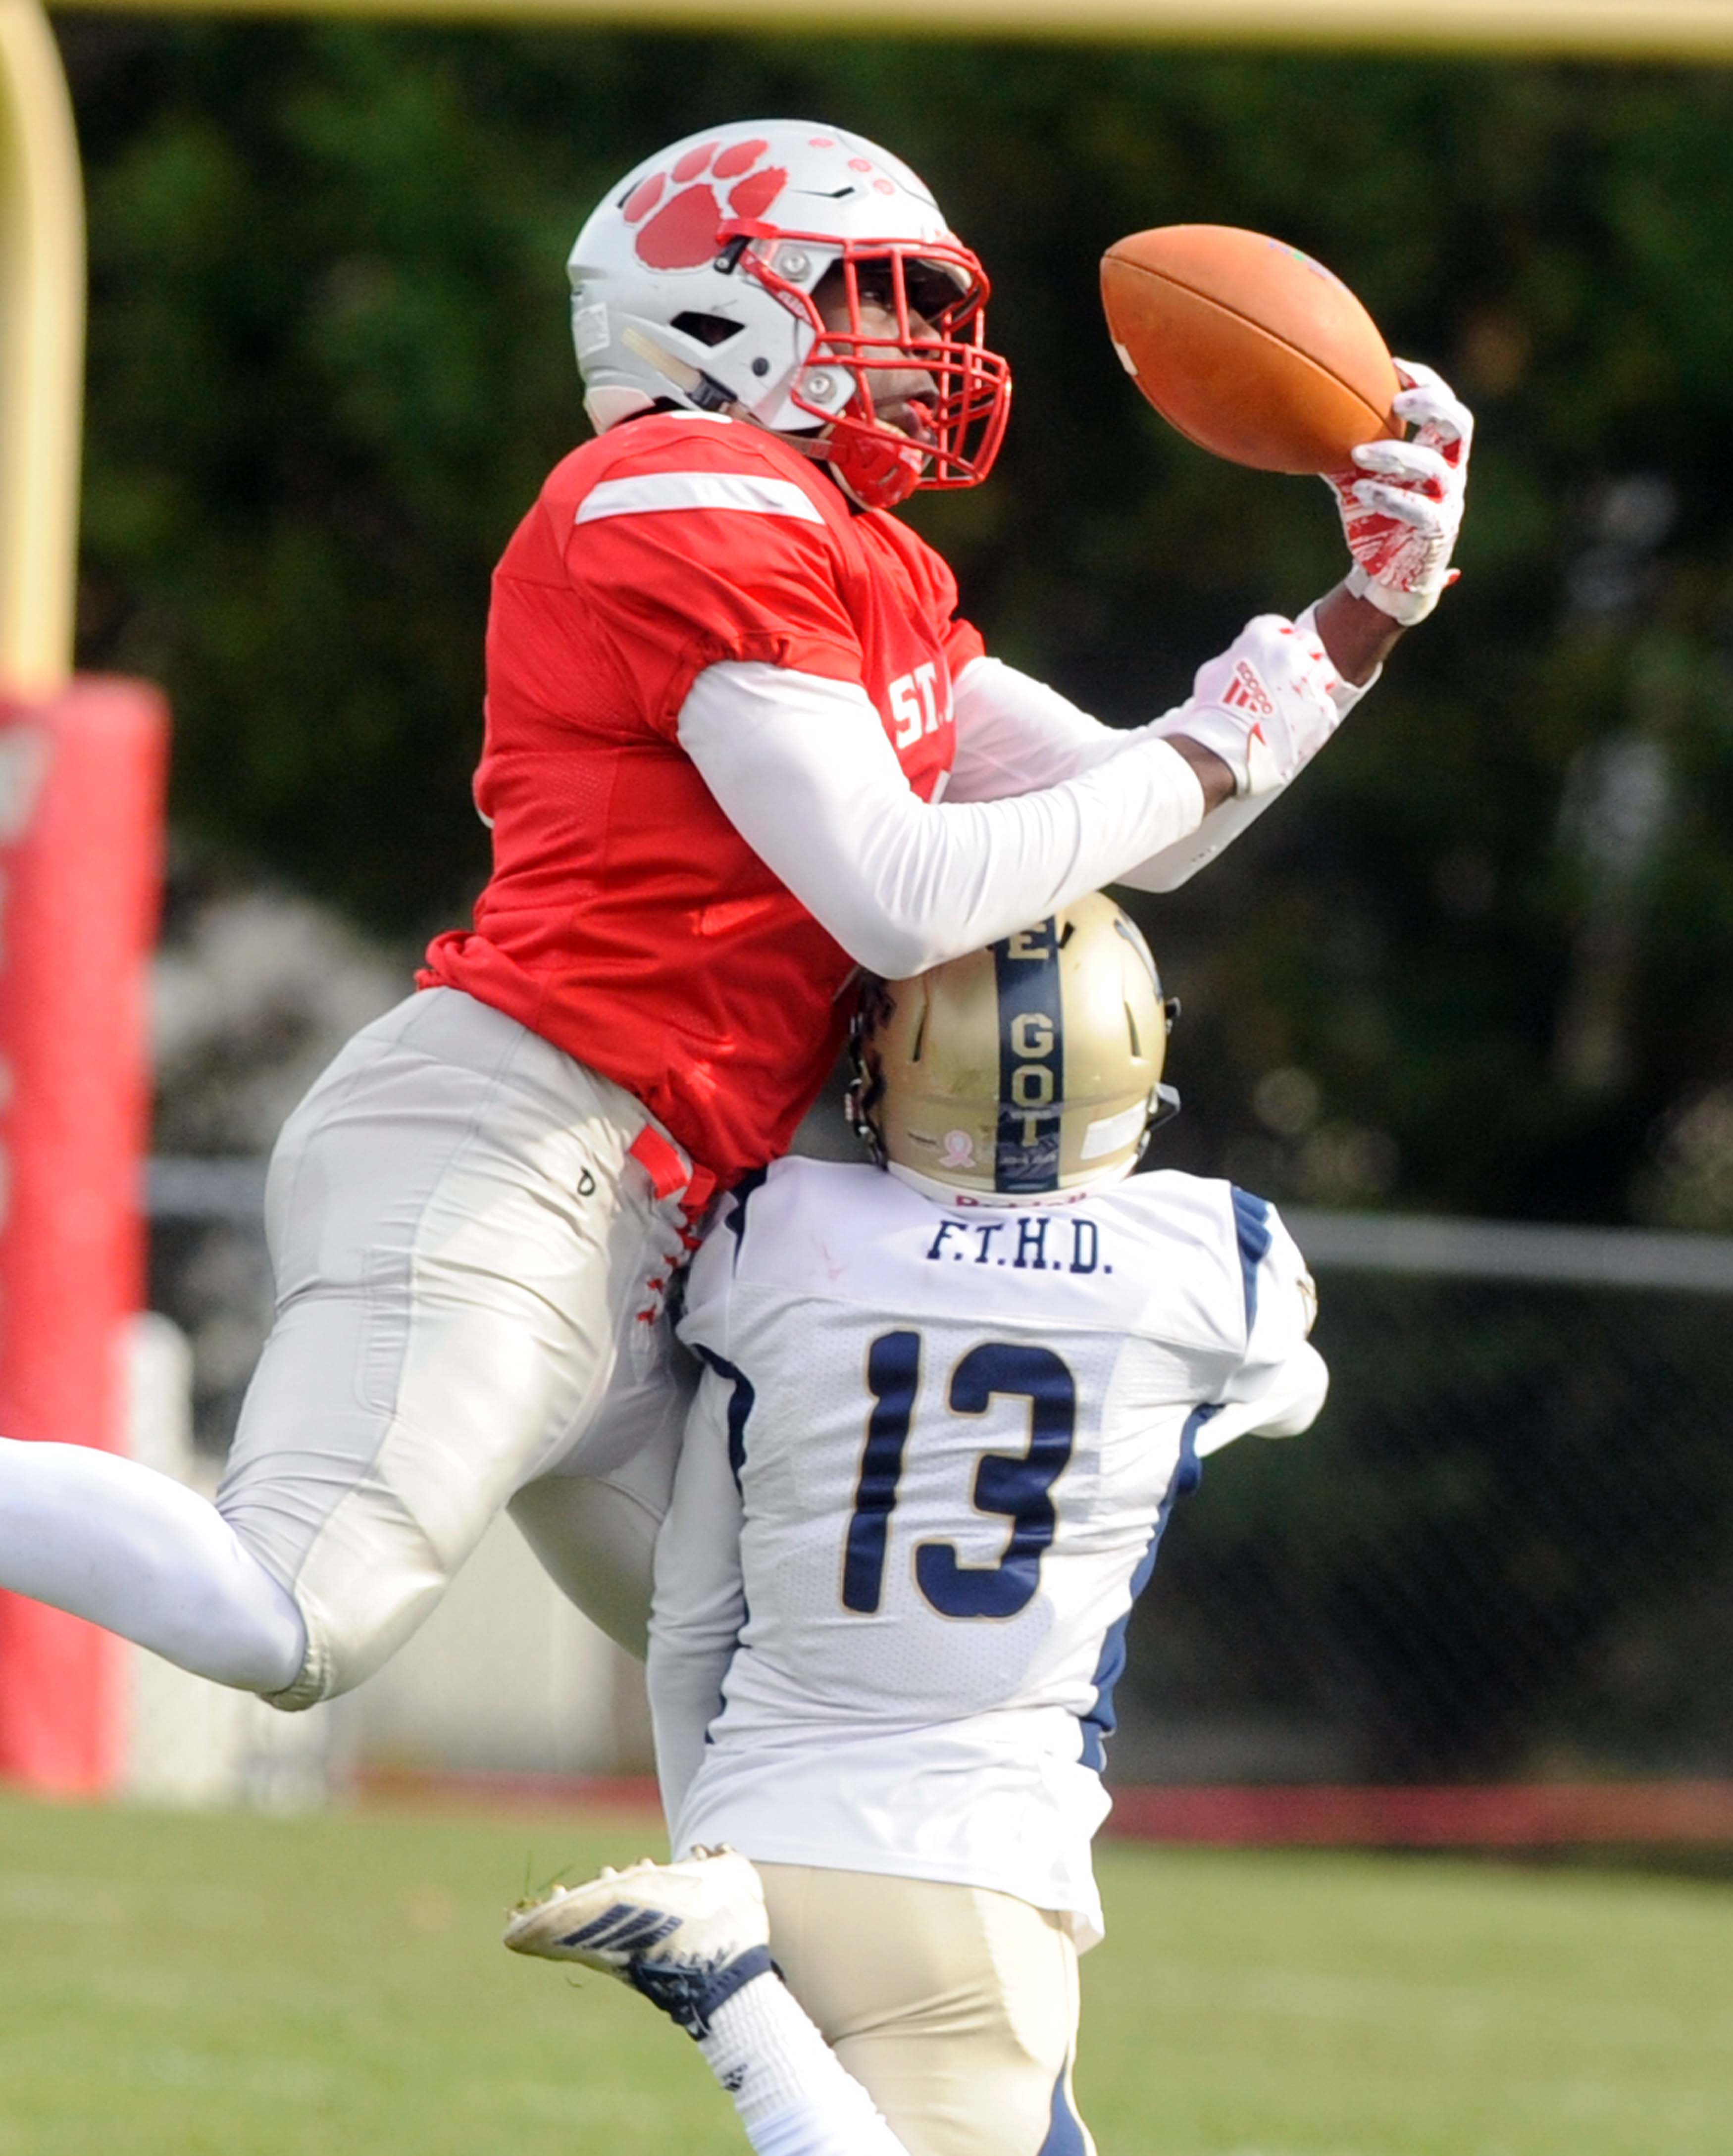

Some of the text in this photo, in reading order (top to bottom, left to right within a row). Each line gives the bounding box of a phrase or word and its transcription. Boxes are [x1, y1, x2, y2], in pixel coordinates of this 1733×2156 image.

[1010, 1012, 1054, 1148] GOT
[926, 1217, 1113, 1274] F.T.H.D.
[841, 1329, 1077, 1622] 13
